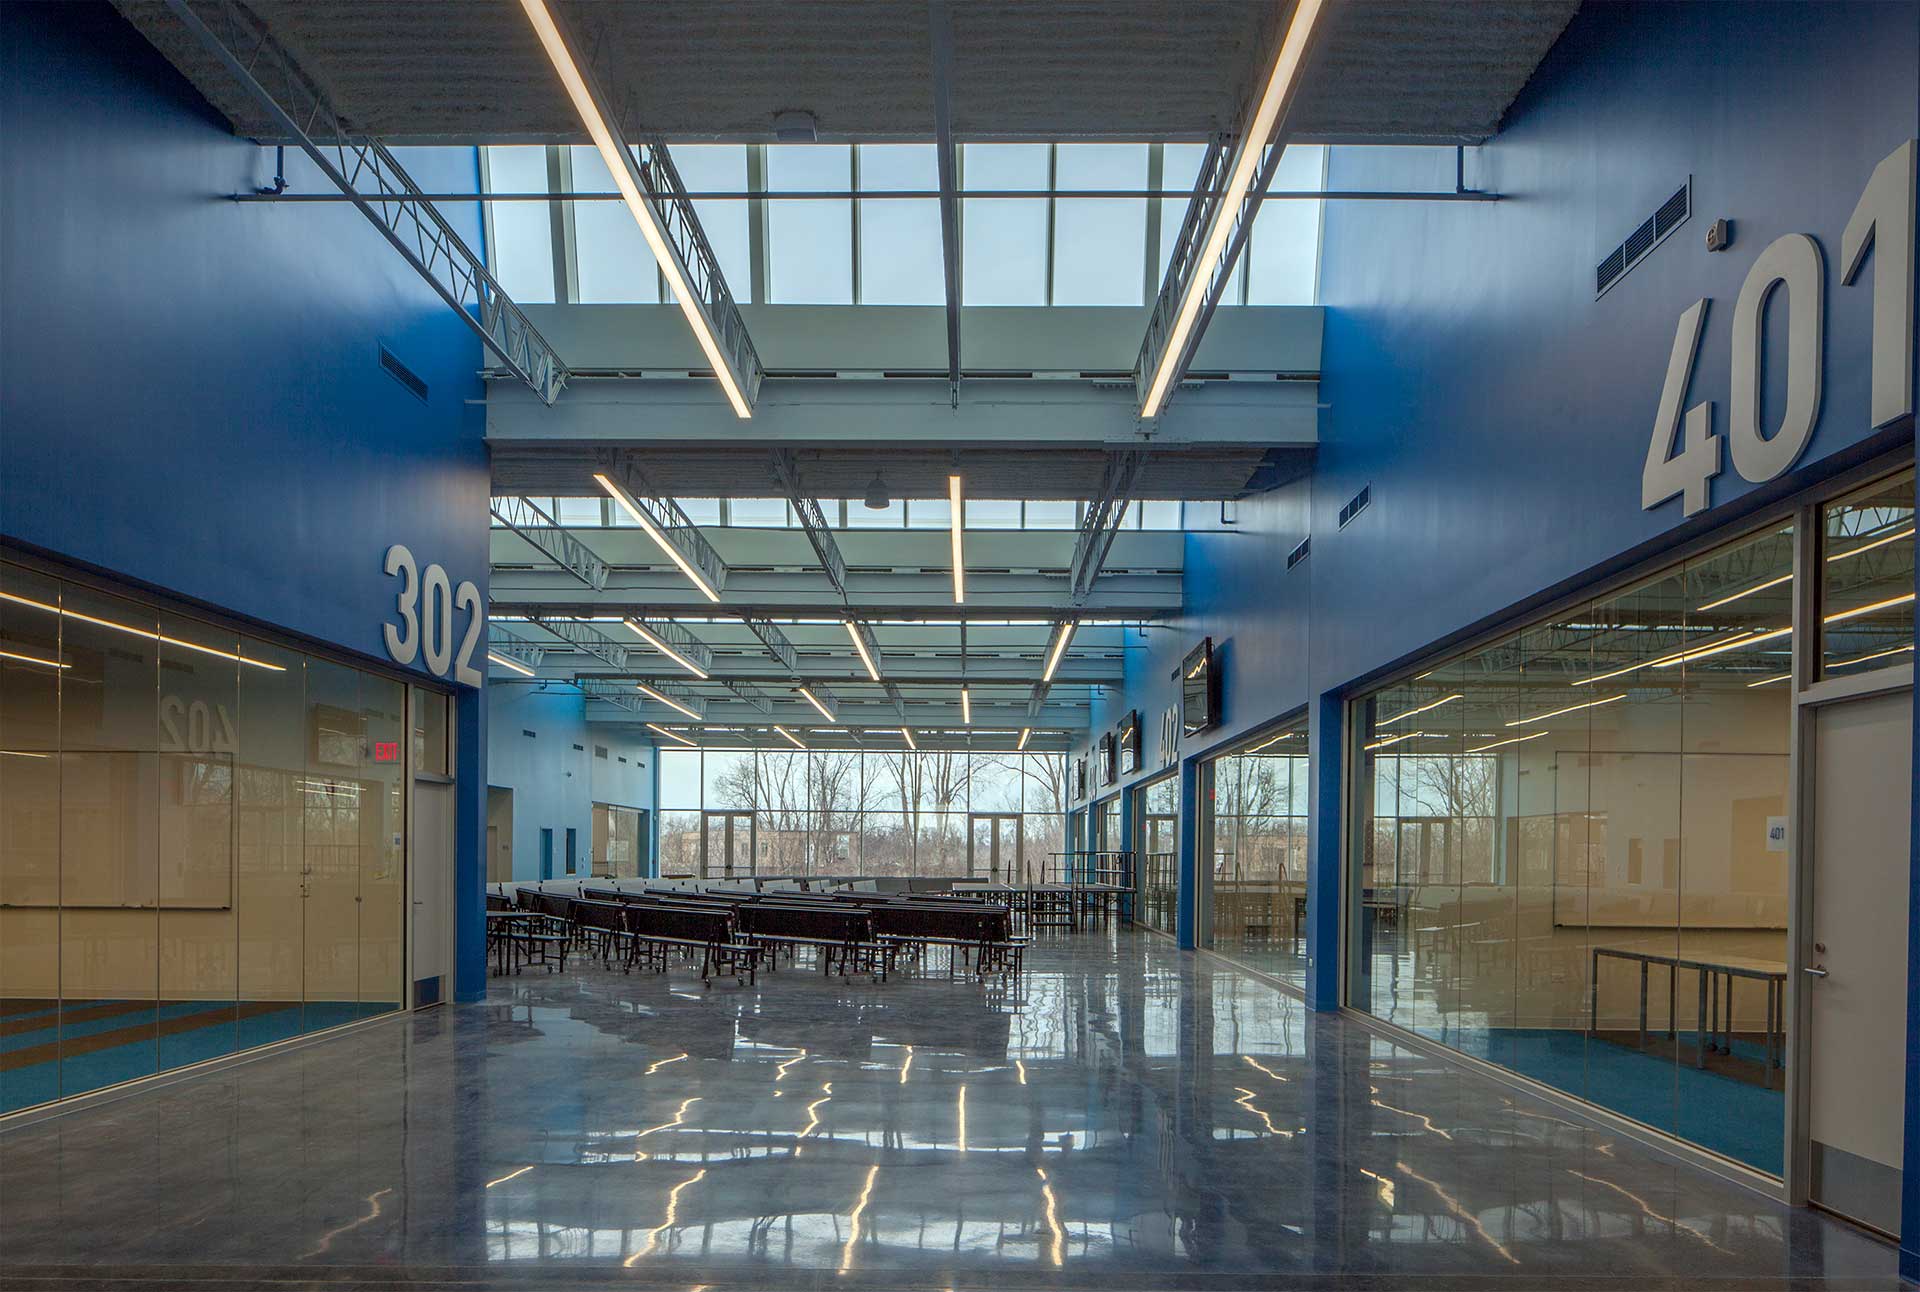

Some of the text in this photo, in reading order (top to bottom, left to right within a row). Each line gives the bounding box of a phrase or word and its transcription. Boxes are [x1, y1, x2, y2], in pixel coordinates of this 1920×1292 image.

[1641, 139, 1917, 518] 401
[384, 544, 482, 688] 302
[375, 741, 398, 762] EXIT
[1769, 826, 1784, 840] 401
